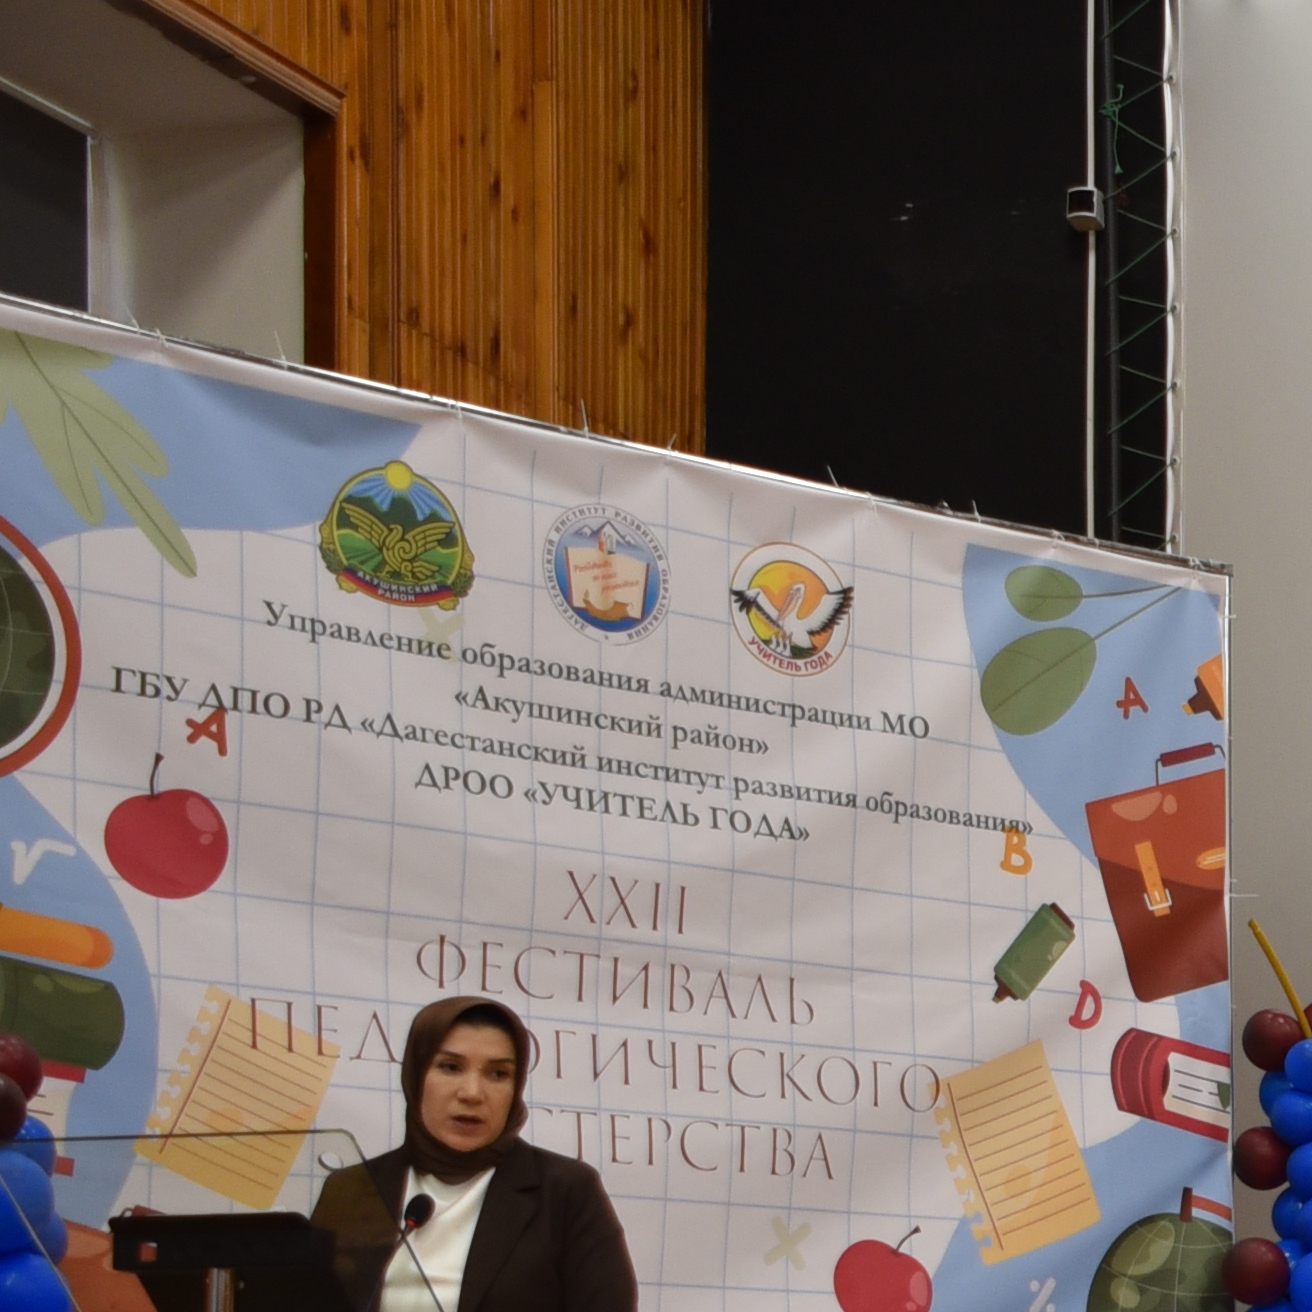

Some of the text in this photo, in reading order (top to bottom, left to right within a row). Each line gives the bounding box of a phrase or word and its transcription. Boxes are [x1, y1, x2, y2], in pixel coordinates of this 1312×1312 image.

[554, 506, 607, 535] ИНСТИТУТ
[614, 512, 664, 561] РАЗВИТИЯ
[357, 571, 438, 594] АКУШИНСКИЙ
[377, 588, 416, 602] РАЙОН
[262, 600, 930, 739] Управление образования администрации МО
[748, 636, 833, 672] УЧИТЕЛЬ ГОДА
[110, 665, 1034, 835] ГБУ ДПО РД «Дагестанский институт развития образования»
[454, 685, 769, 755] «Акушинский район»
[414, 762, 811, 842] ДРОО «УЧИТЕЛЬ ГОДА»
[562, 870, 687, 935] XXII
[415, 934, 816, 1027] ФЕСТИВАЛЬ
[248, 996, 942, 1114] ПЕДГИЧЕСКОГО
